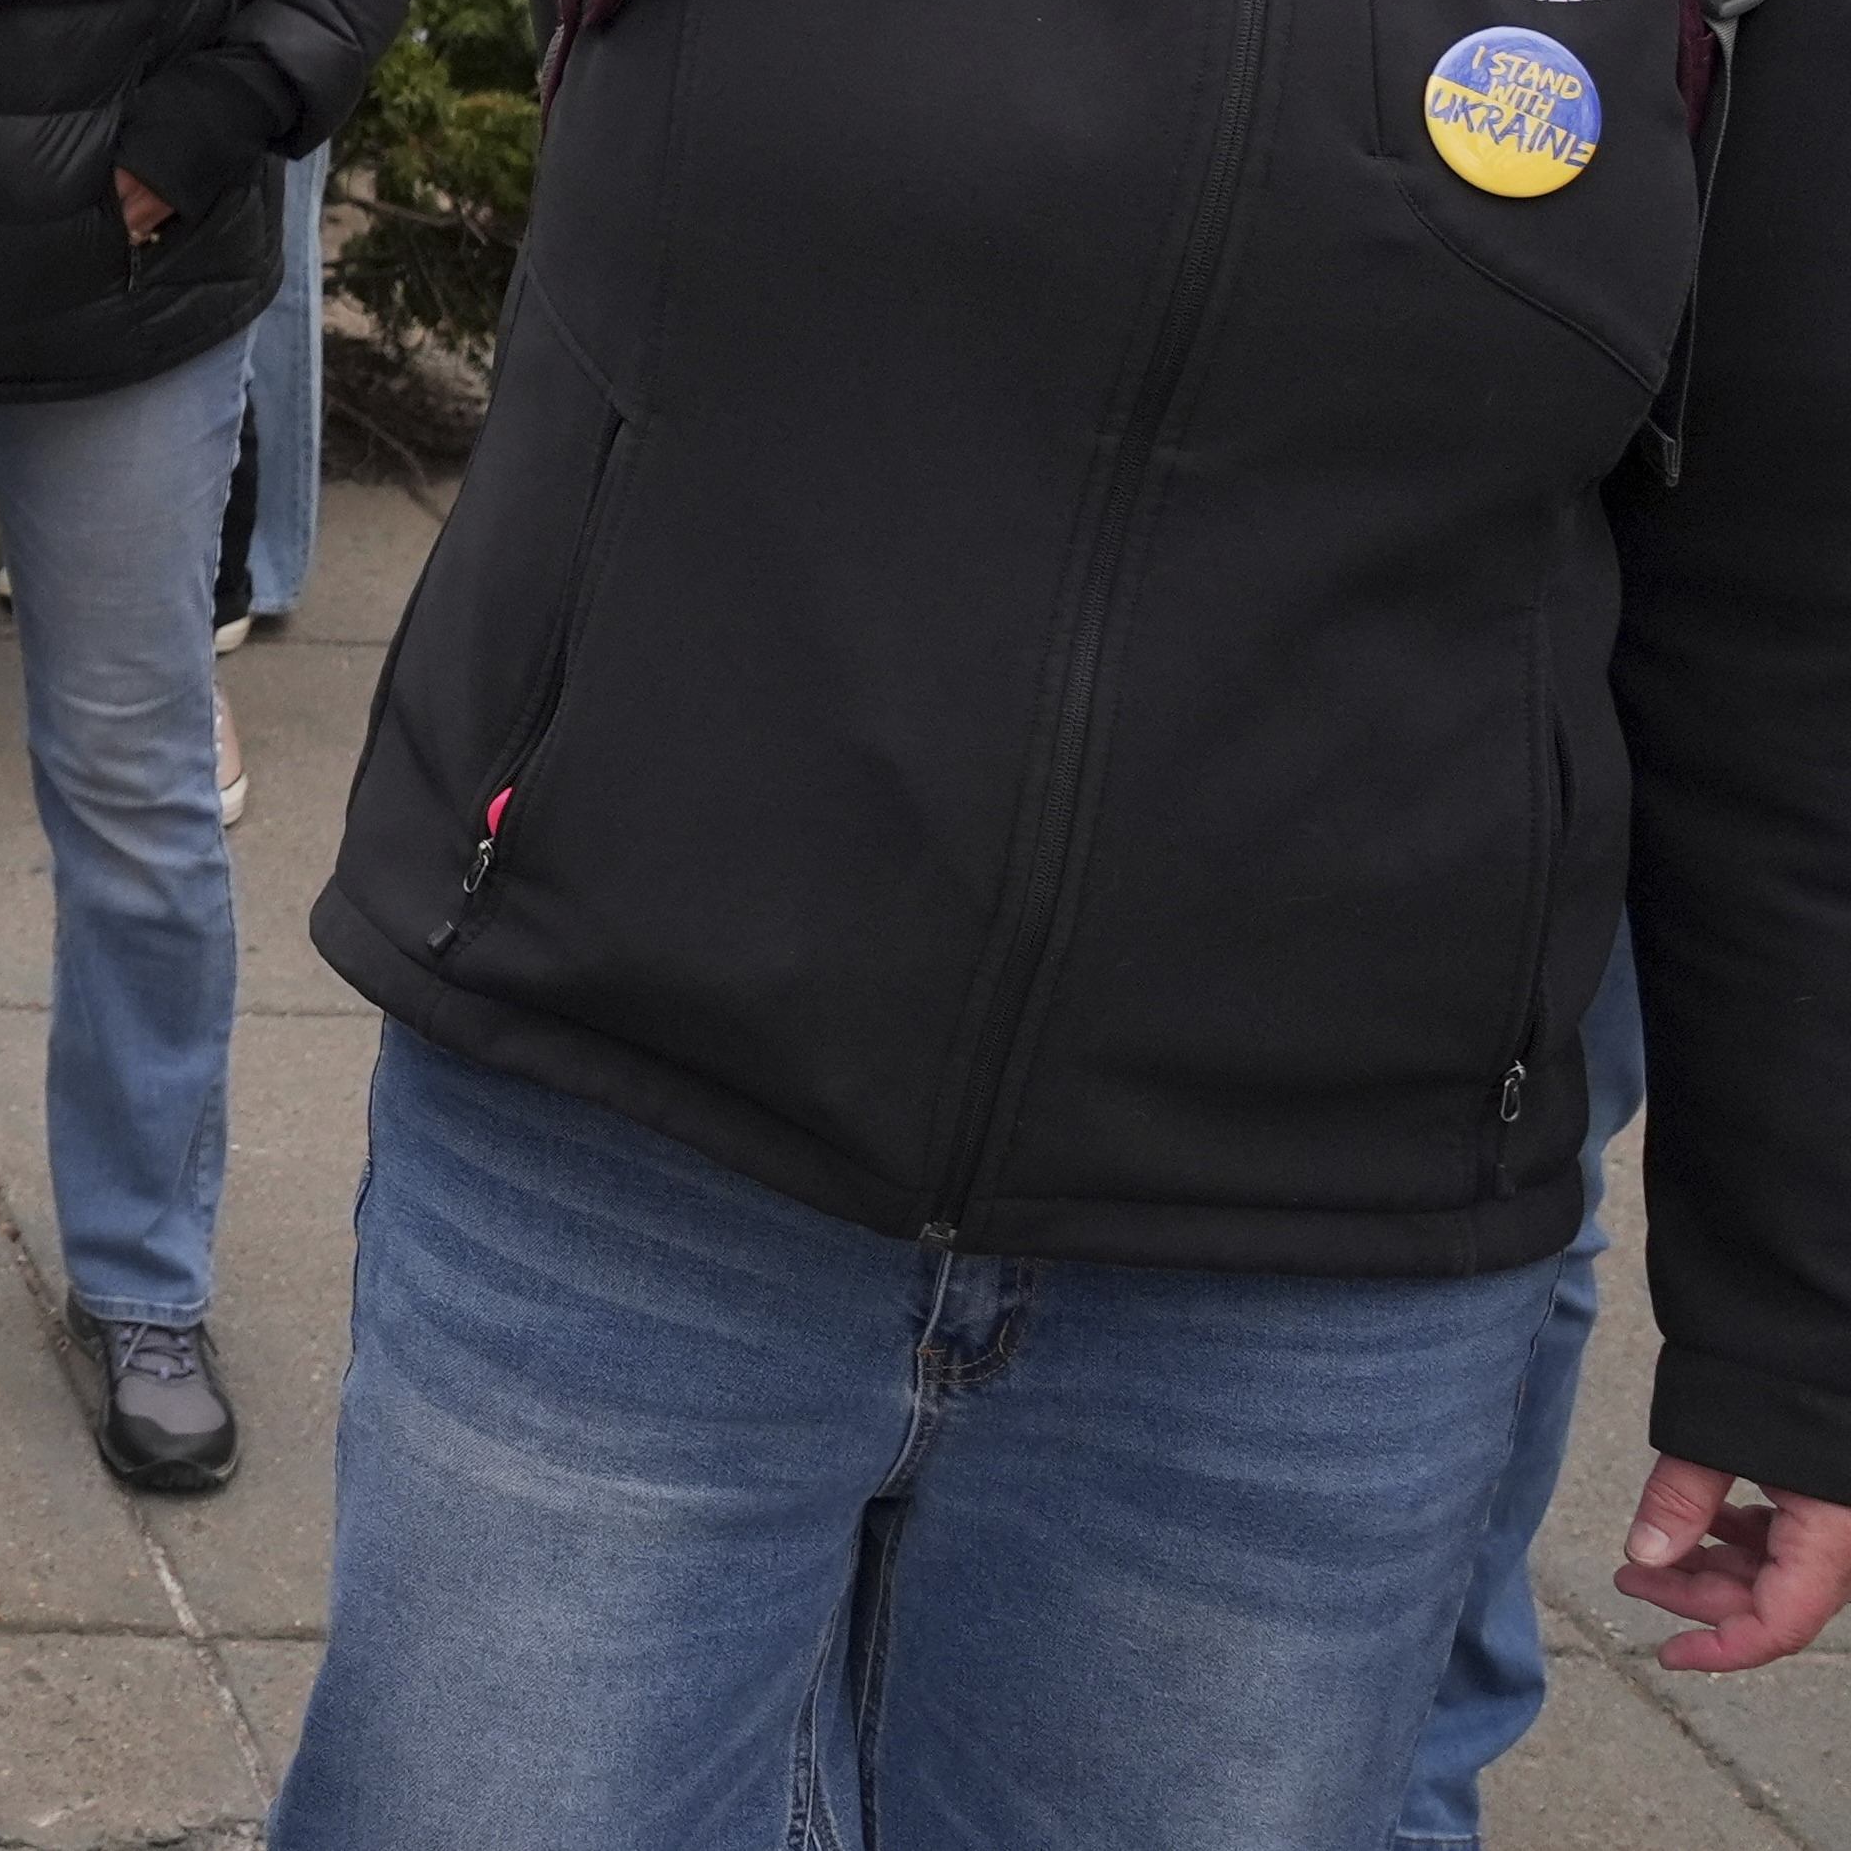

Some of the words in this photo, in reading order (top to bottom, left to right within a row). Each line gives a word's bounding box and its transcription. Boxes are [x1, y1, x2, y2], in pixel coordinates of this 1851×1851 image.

[1471, 45, 1487, 70] I
[1488, 52, 1583, 99] STAND
[1487, 78, 1556, 120] WITH
[1429, 88, 1596, 168] UKRAINE
